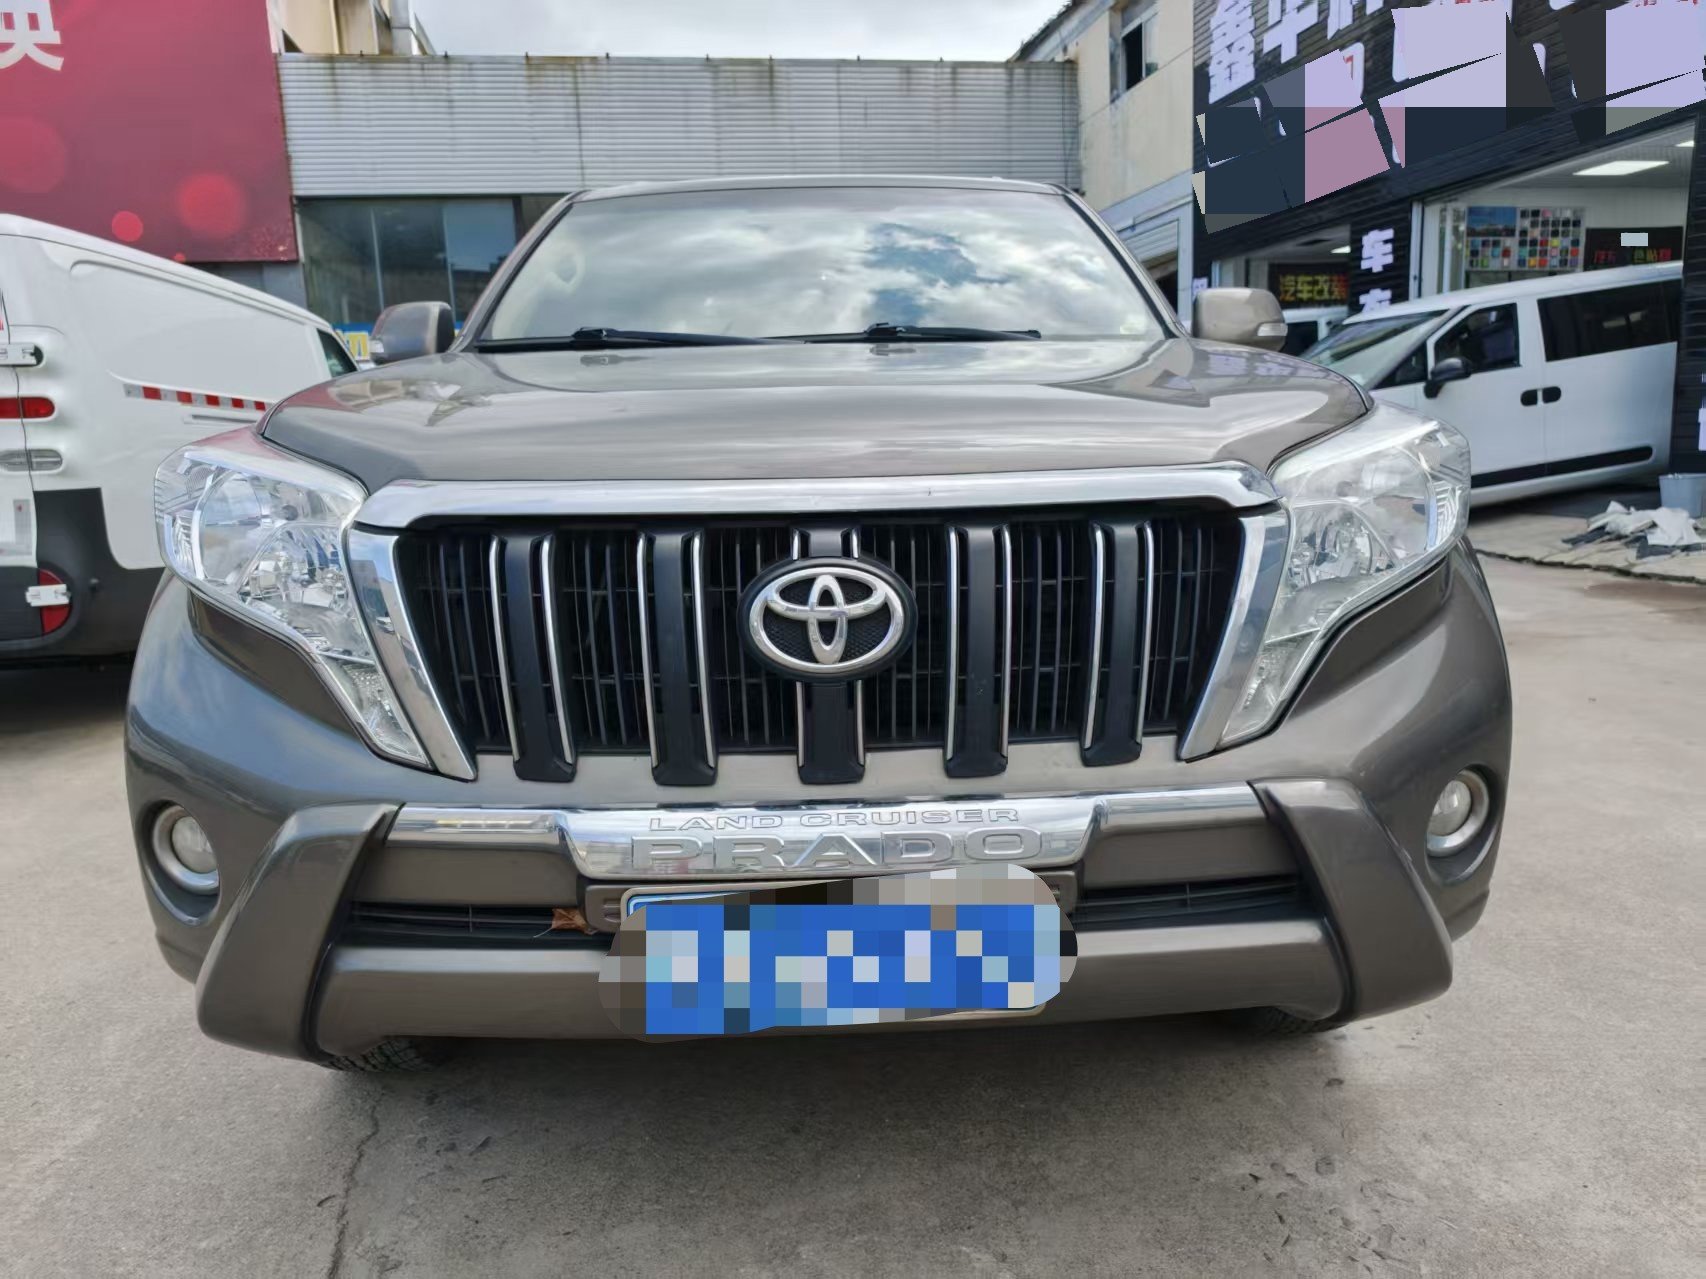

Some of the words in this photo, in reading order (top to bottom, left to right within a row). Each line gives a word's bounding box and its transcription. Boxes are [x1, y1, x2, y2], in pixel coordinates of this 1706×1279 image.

[650, 814, 783, 831] LAND
[800, 808, 1019, 827] CRUISER
[631, 826, 1043, 872] PRADO
